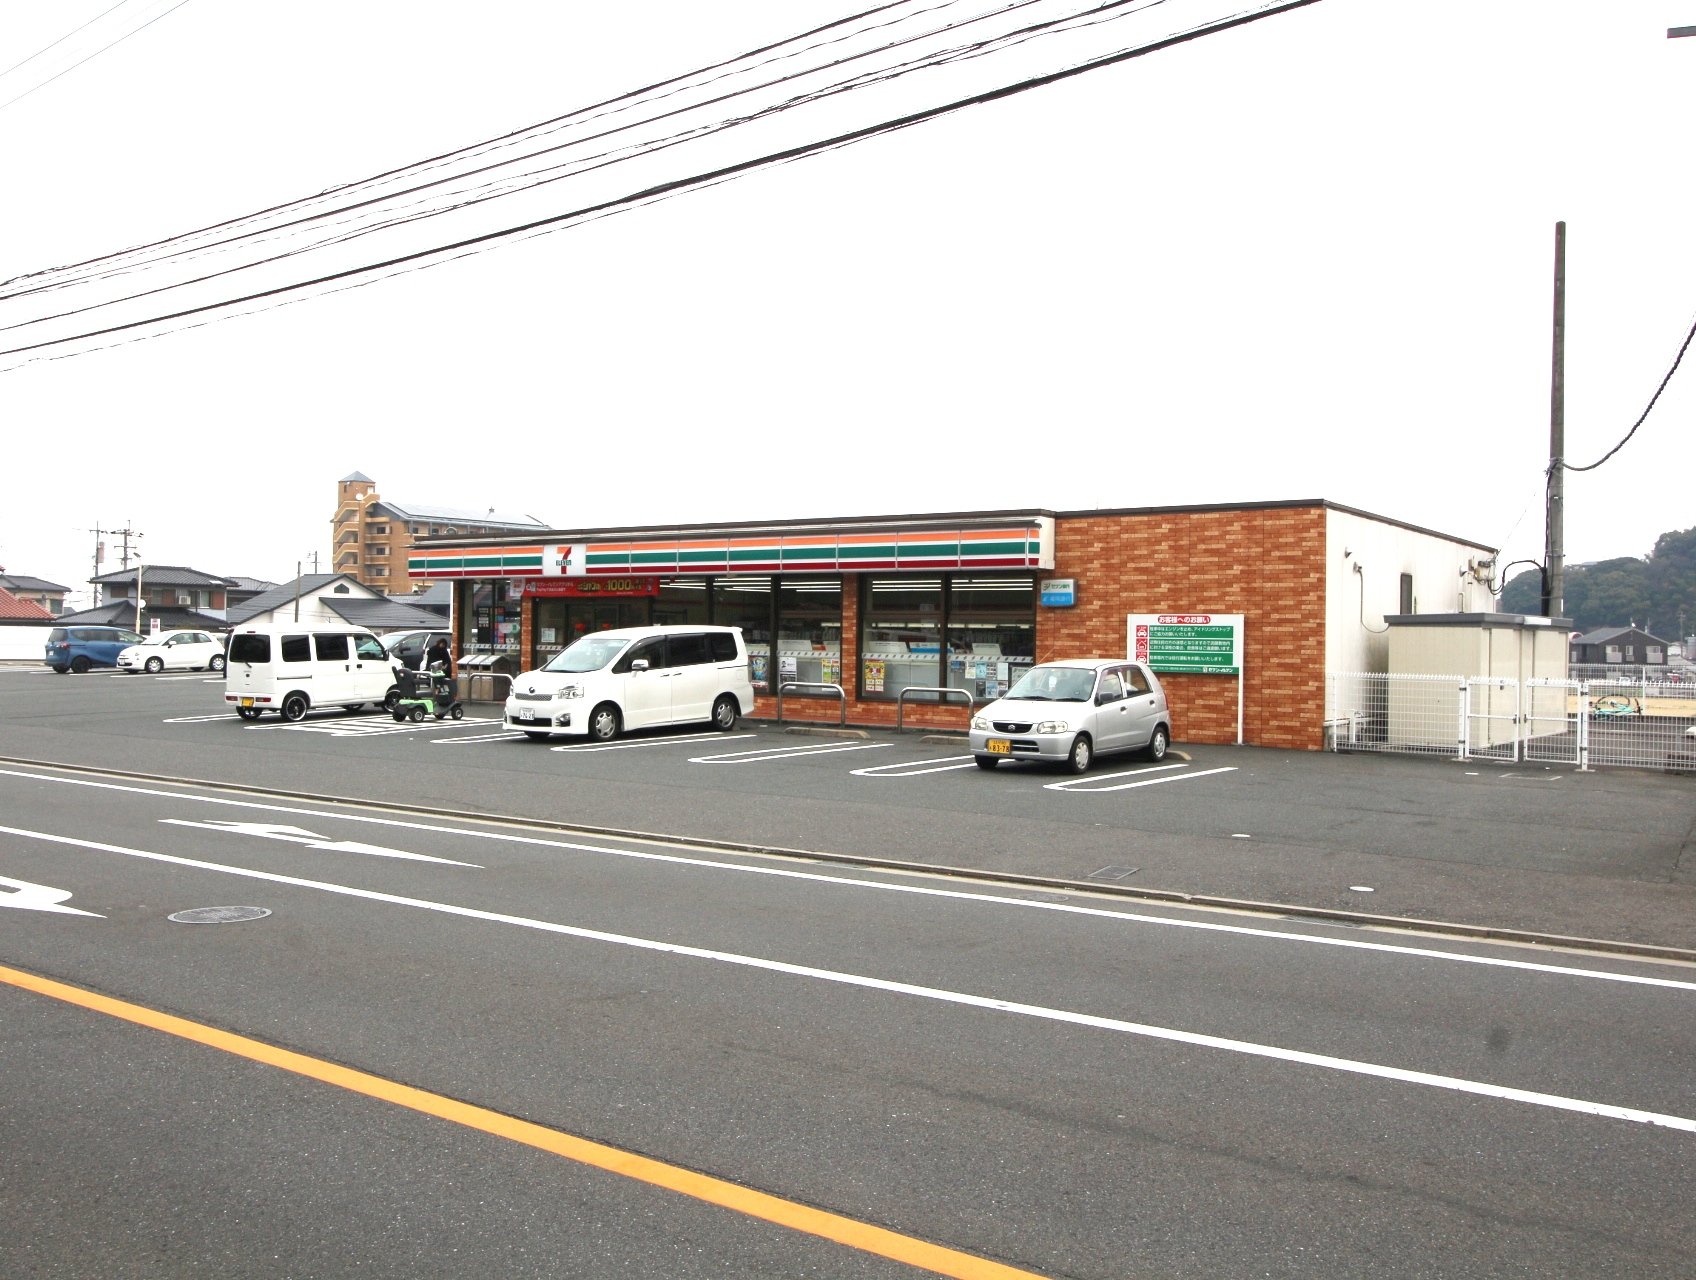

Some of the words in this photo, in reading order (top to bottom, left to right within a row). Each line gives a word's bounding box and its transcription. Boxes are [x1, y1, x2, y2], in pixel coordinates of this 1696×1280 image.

[556, 545, 572, 575] 7
[1159, 616, 1210, 624] お客様へのお願い
